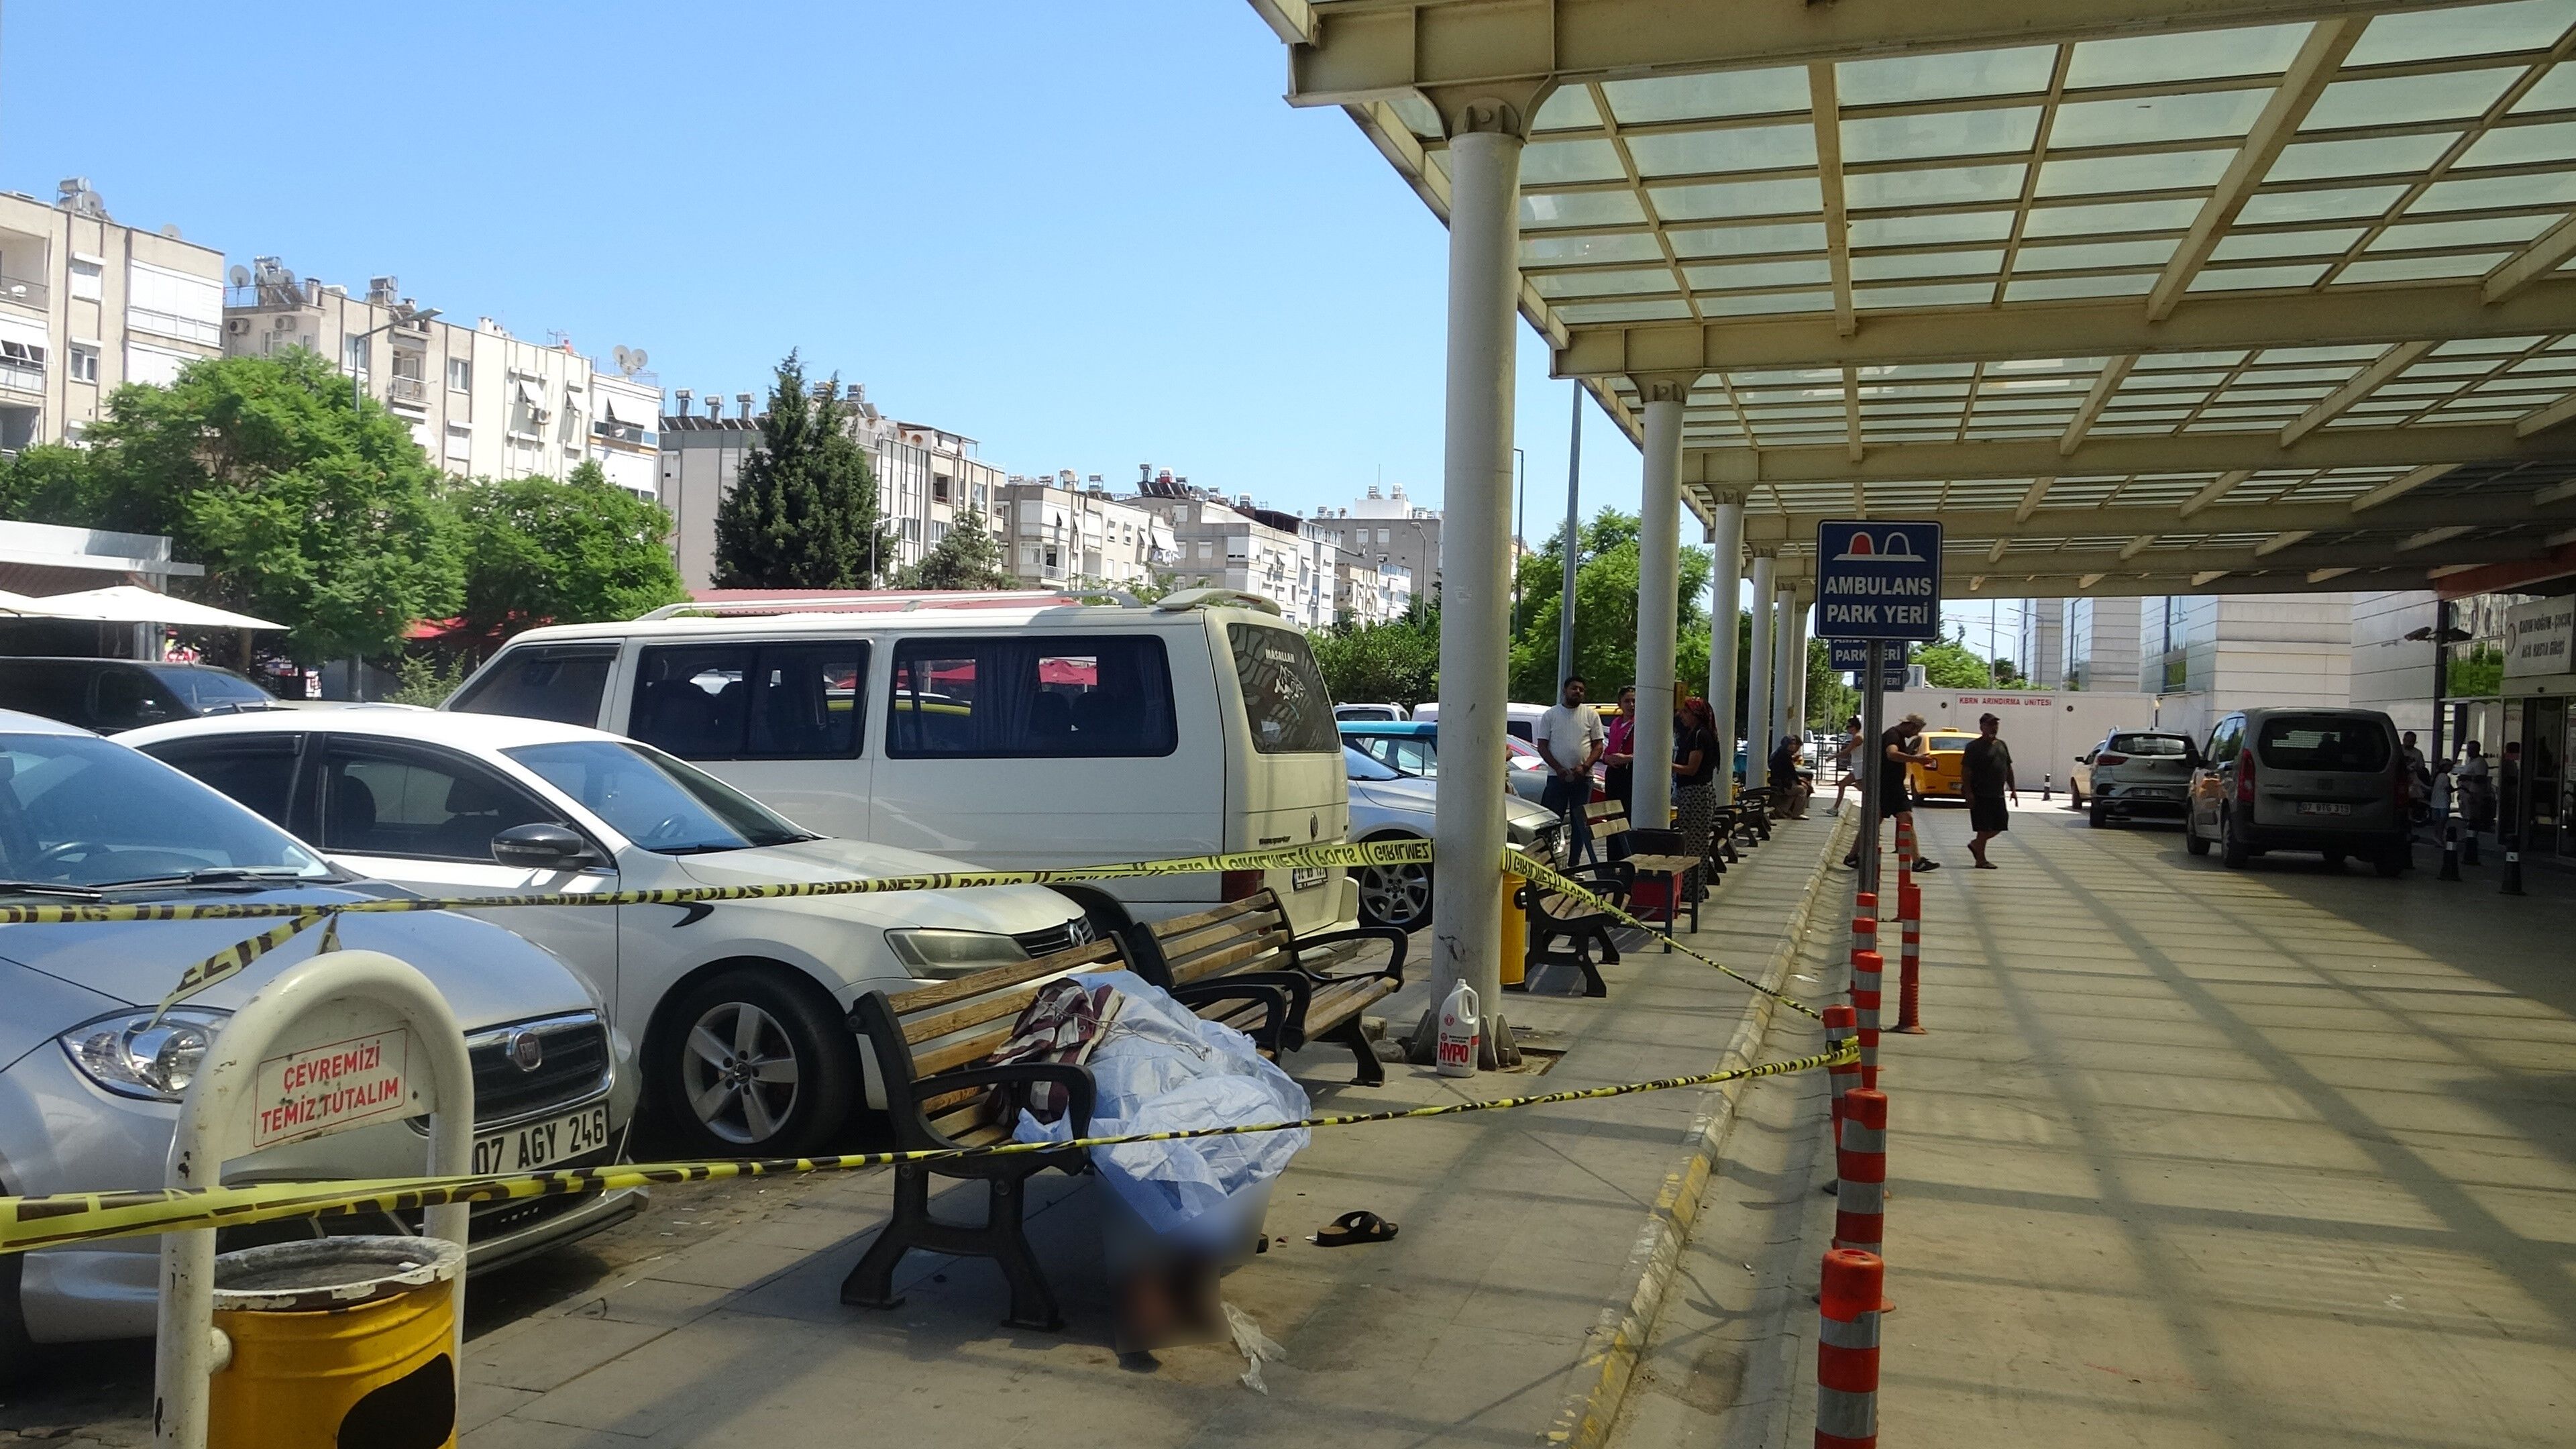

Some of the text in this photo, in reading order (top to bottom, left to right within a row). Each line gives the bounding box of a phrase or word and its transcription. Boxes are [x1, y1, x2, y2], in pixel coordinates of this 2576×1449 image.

[1825, 576, 1932, 596] AMBULANS
[1827, 601, 1929, 625] PARK YERİ
[1835, 646, 1900, 661] PARK ERİ
[1982, 698, 2021, 706] ARINDIRMA
[1439, 1041, 1468, 1063] HYPO
[283, 1039, 381, 1094] ÇEVREMİZİ
[261, 1077, 399, 1134] TEMİZ TUTALIM
[474, 1110, 604, 1175] 07 AGY 246
